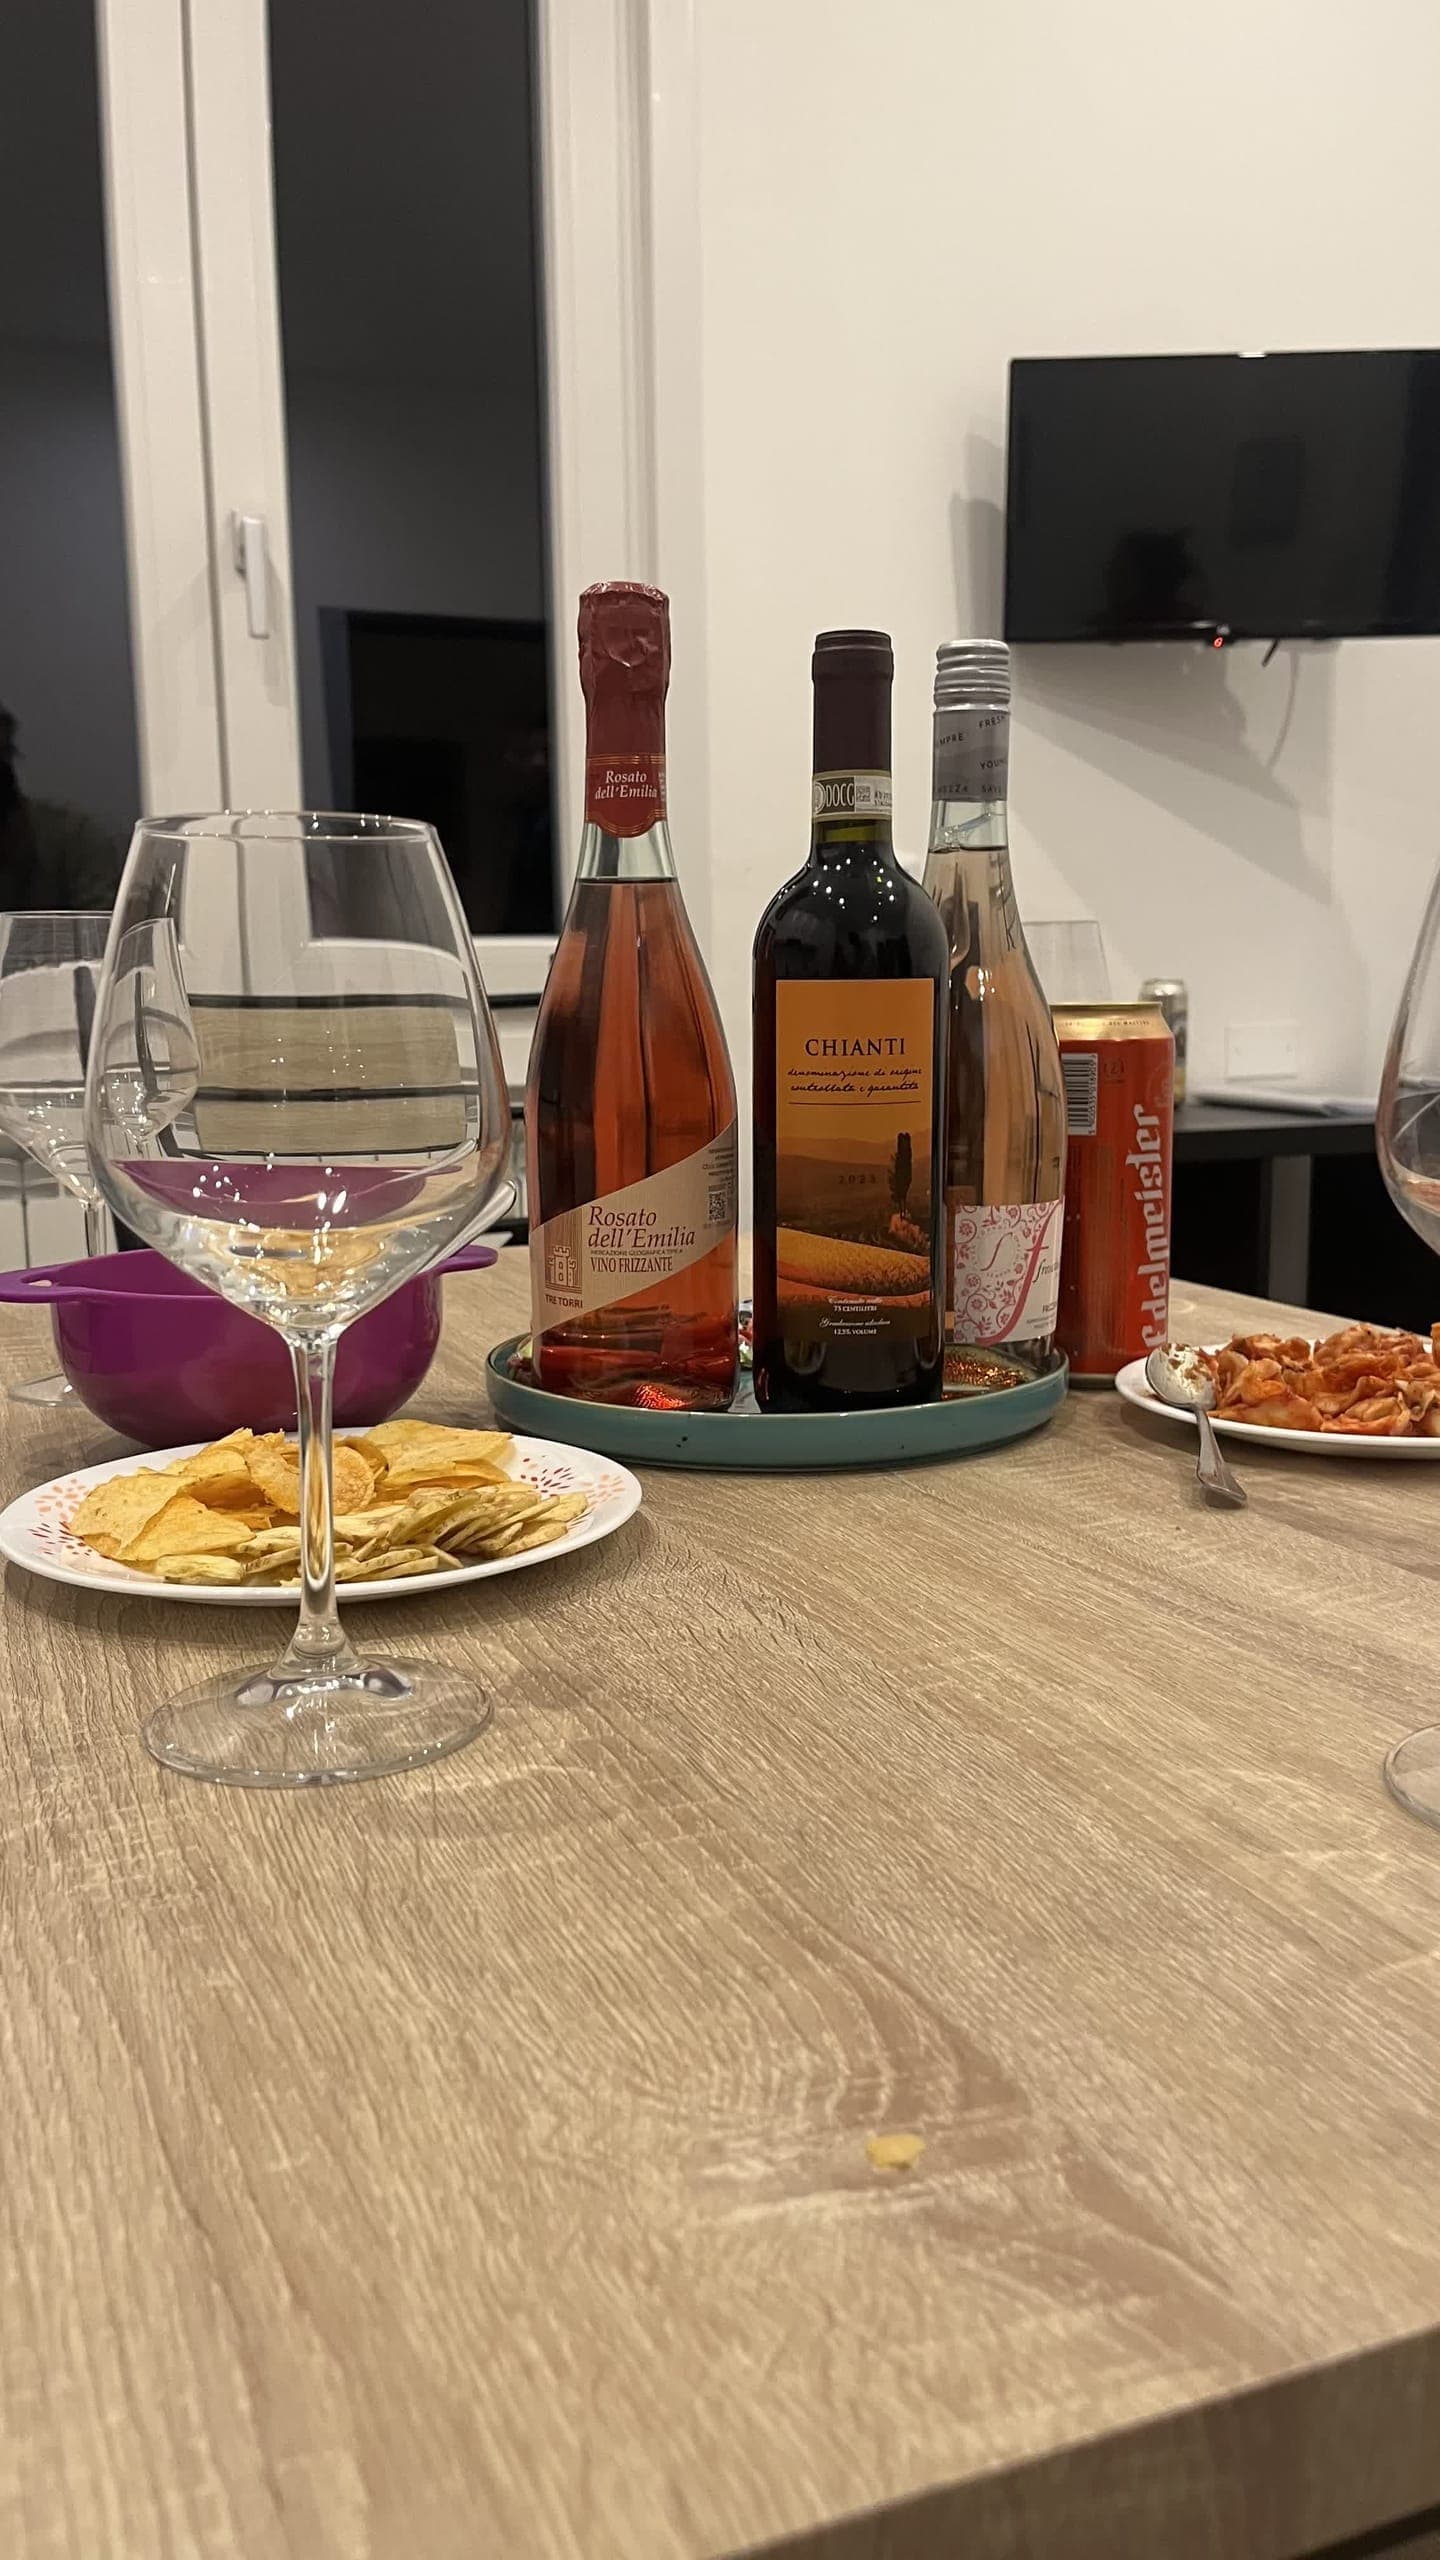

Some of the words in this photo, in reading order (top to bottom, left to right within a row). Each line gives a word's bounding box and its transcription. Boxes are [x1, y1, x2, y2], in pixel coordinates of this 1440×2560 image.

[605, 770, 647, 784] Rosato
[595, 784, 658, 800] dell'Emilia
[805, 1038, 906, 1057] CHIANTI
[787, 1068, 870, 1082] denominazione
[874, 1067, 885, 1077] di
[889, 1067, 923, 1081] origine
[790, 1081, 856, 1093] controllata
[866, 1080, 919, 1097] garantita
[588, 1205, 657, 1226] Rosato
[1125, 1103, 1169, 1348] Edelmeister
[588, 1227, 696, 1248] dell'Emilia
[590, 1257, 617, 1272] VINO
[619, 1256, 673, 1272] FRIZZANTE
[545, 1293, 557, 1304] TRE
[559, 1295, 583, 1308] TORRI
